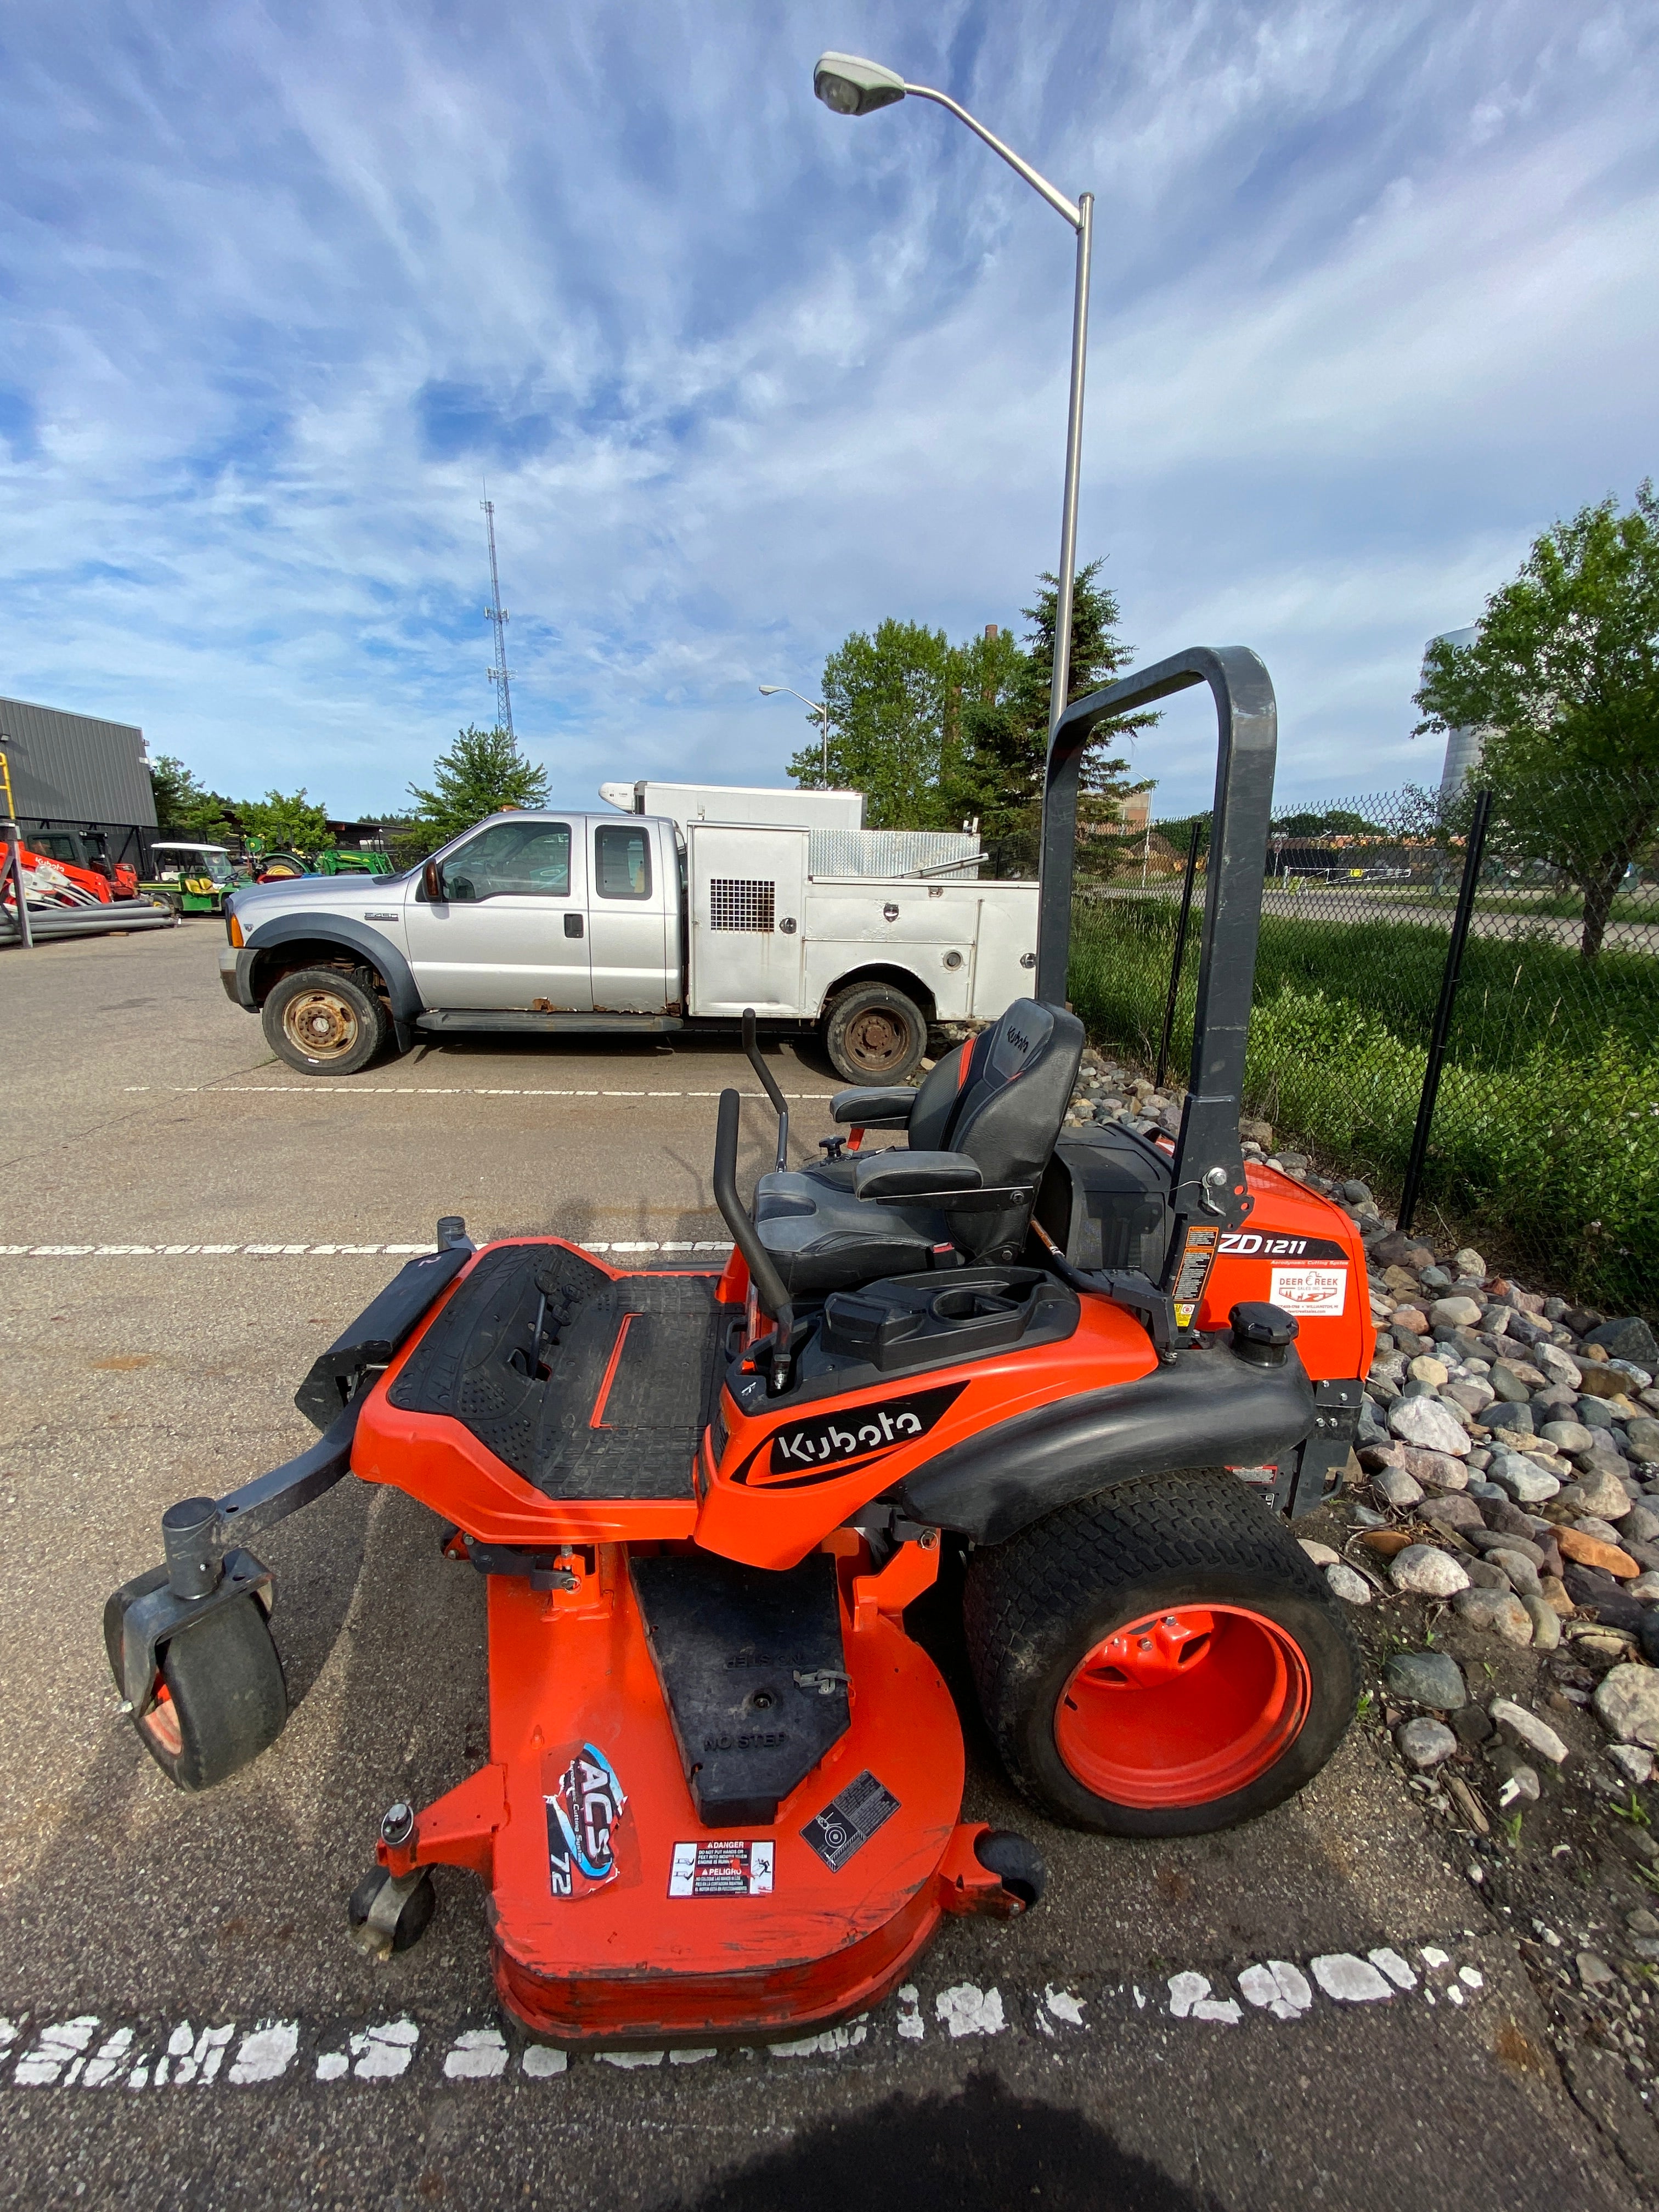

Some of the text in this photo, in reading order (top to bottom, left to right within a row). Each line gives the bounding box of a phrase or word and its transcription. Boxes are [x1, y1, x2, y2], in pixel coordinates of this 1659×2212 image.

[35, 856, 65, 873] Kubota
[1007, 1025, 1029, 1053] Kubota
[1217, 1233, 1263, 1254] ZD
[1263, 1239, 1307, 1254] 1211
[1306, 1276, 1338, 1285] CREEK
[778, 1412, 922, 1462] Kubota
[704, 1731, 786, 1752] NO STEP
[579, 1759, 613, 1858] ACS
[550, 1852, 572, 1895] 72
